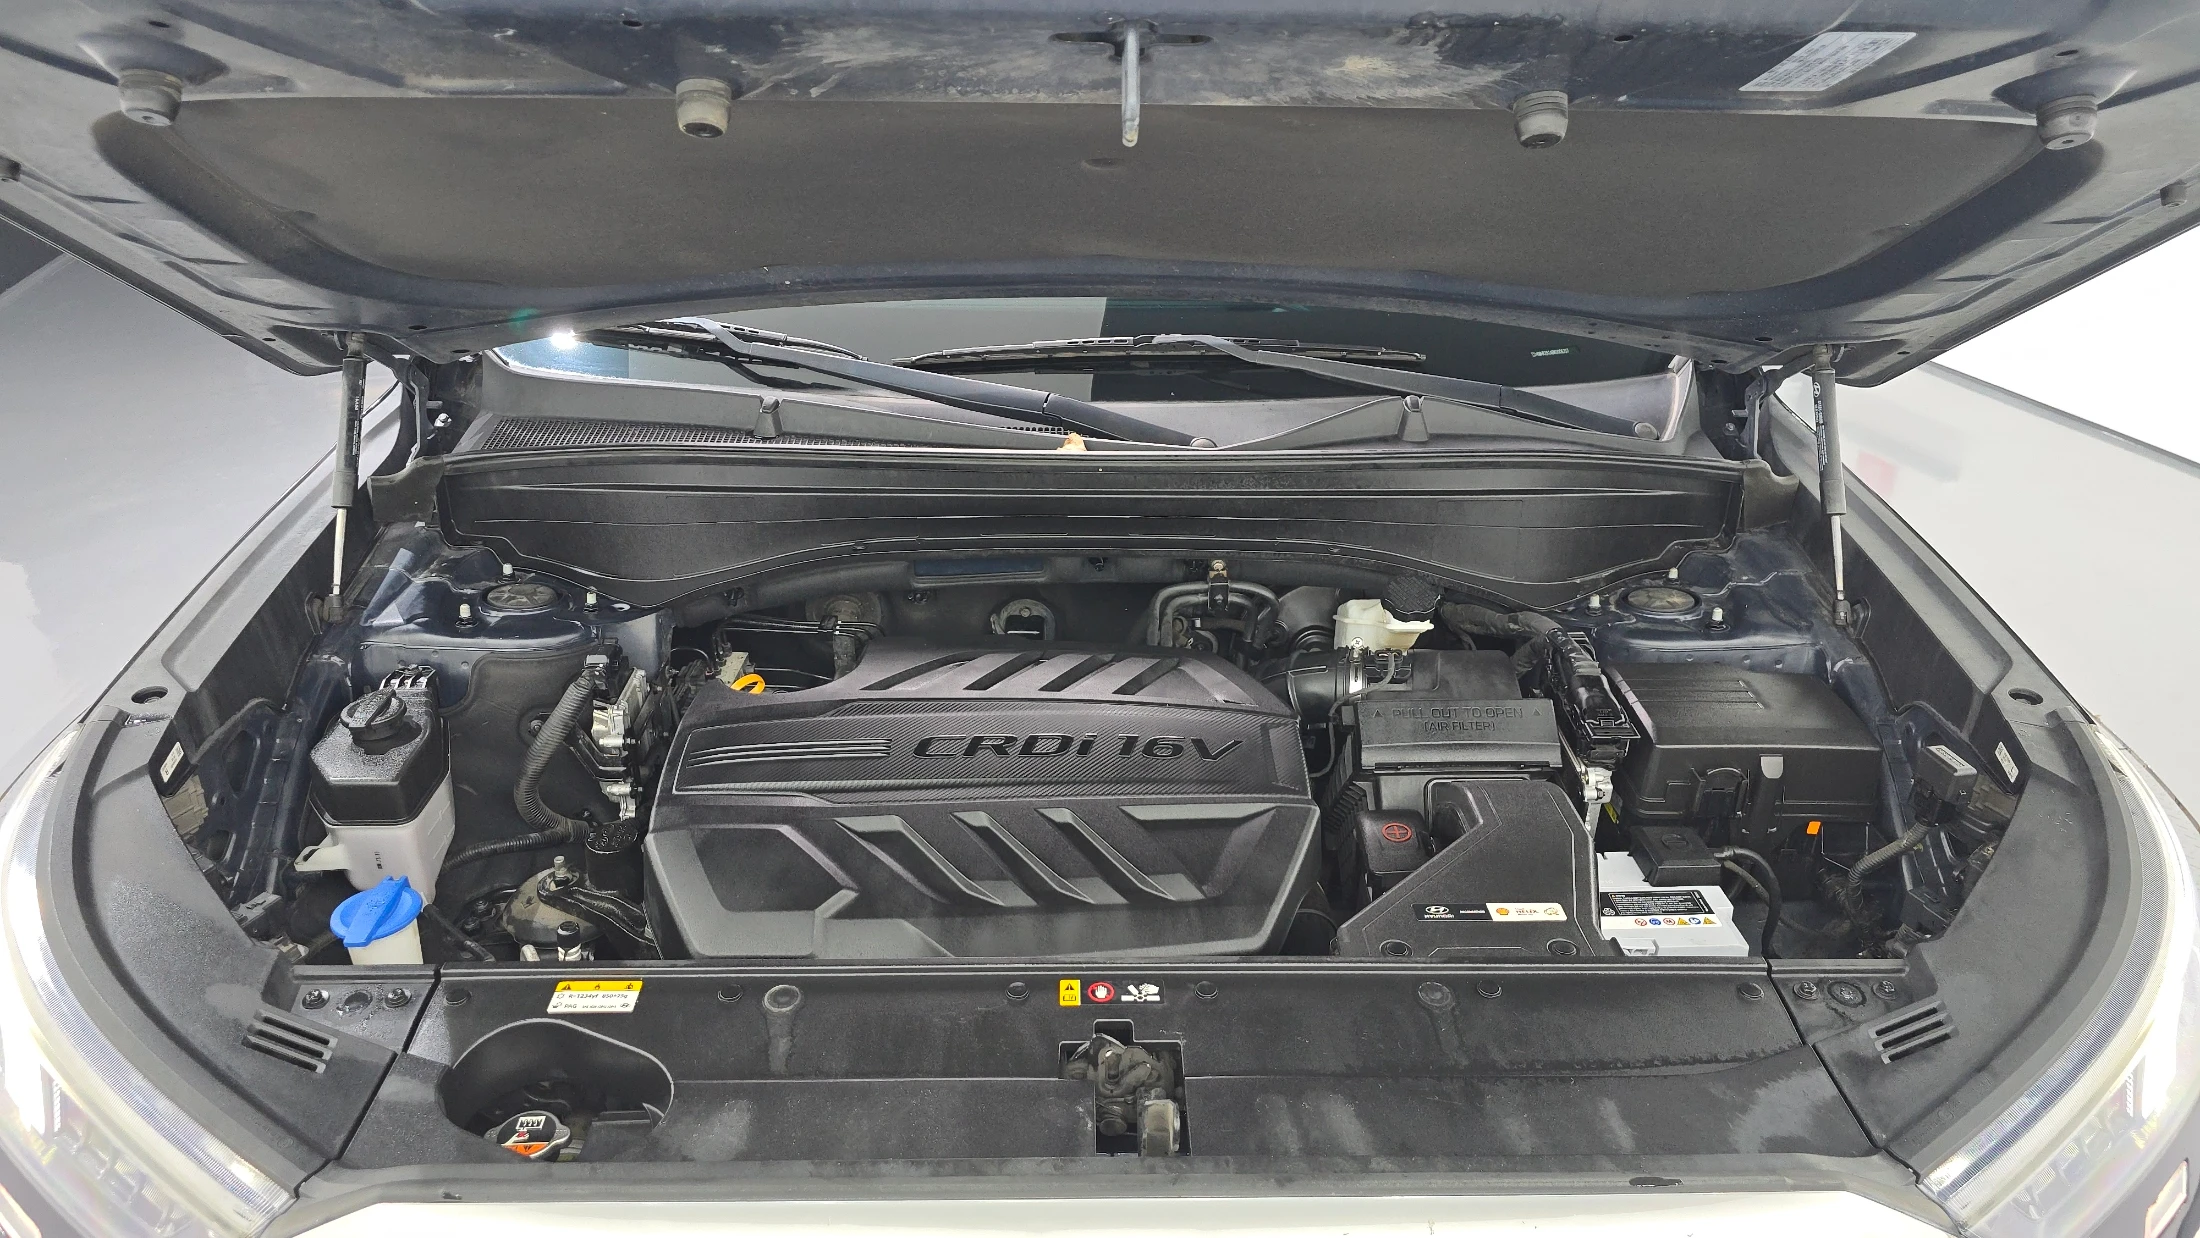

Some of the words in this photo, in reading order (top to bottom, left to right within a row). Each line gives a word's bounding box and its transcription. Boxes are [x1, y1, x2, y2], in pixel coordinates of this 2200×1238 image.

[1392, 707, 1428, 719] PULL
[1431, 707, 1459, 718] OUT
[1464, 707, 1482, 718] TO
[1486, 706, 1523, 718] OPEN
[912, 732, 1098, 759] CRDi
[1118, 733, 1244, 762] 16V
